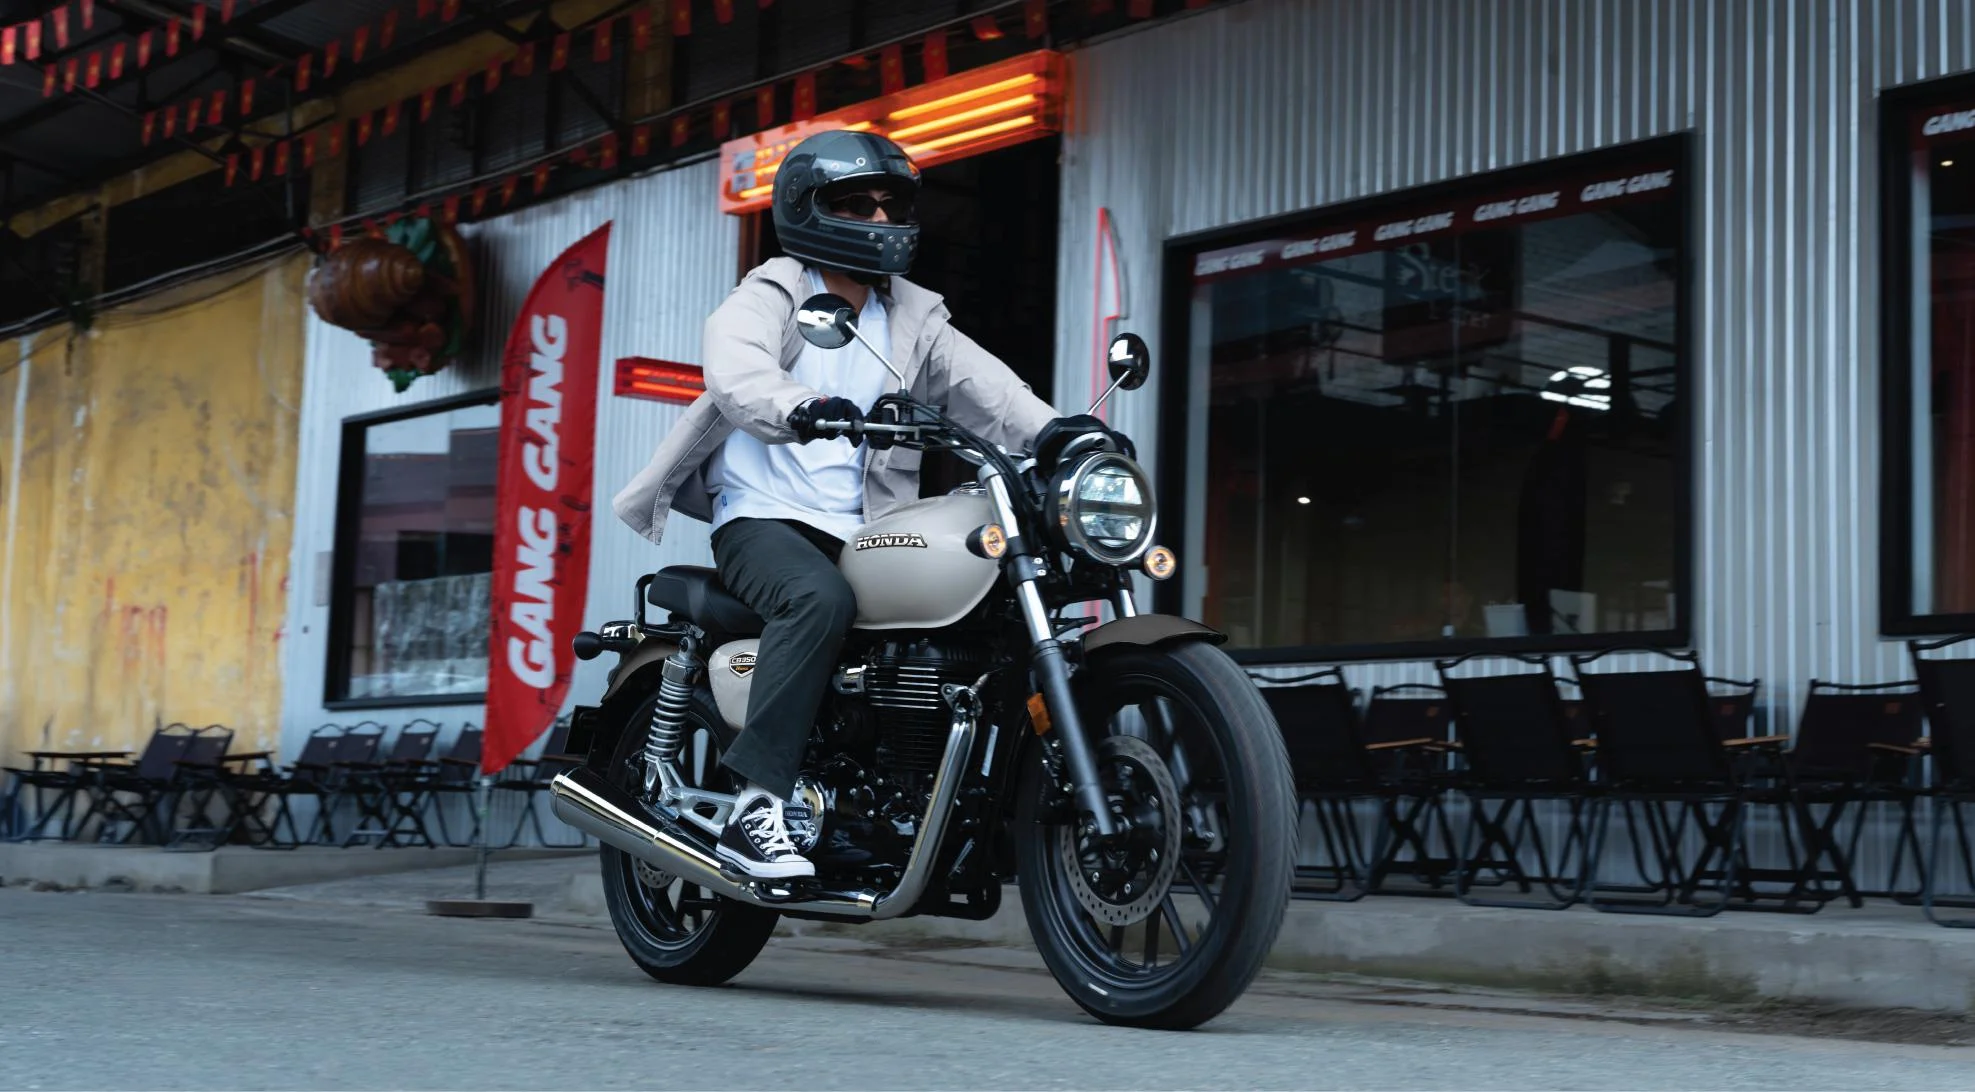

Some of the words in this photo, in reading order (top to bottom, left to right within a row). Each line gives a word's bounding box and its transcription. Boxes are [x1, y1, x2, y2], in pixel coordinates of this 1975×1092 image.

[1580, 178, 1627, 203] GANG
[1627, 169, 1674, 194] GANG
[1472, 199, 1516, 222] GANG
[1516, 190, 1561, 214] GANG
[1373, 219, 1414, 241] GANG
[1414, 211, 1455, 234] GANG
[1318, 230, 1357, 253] GANG
[523, 312, 569, 493] GANG
[856, 532, 928, 551] HONDA
[507, 506, 557, 691] GANG
[731, 656, 757, 664] CB350
[784, 810, 808, 818] HONDA
